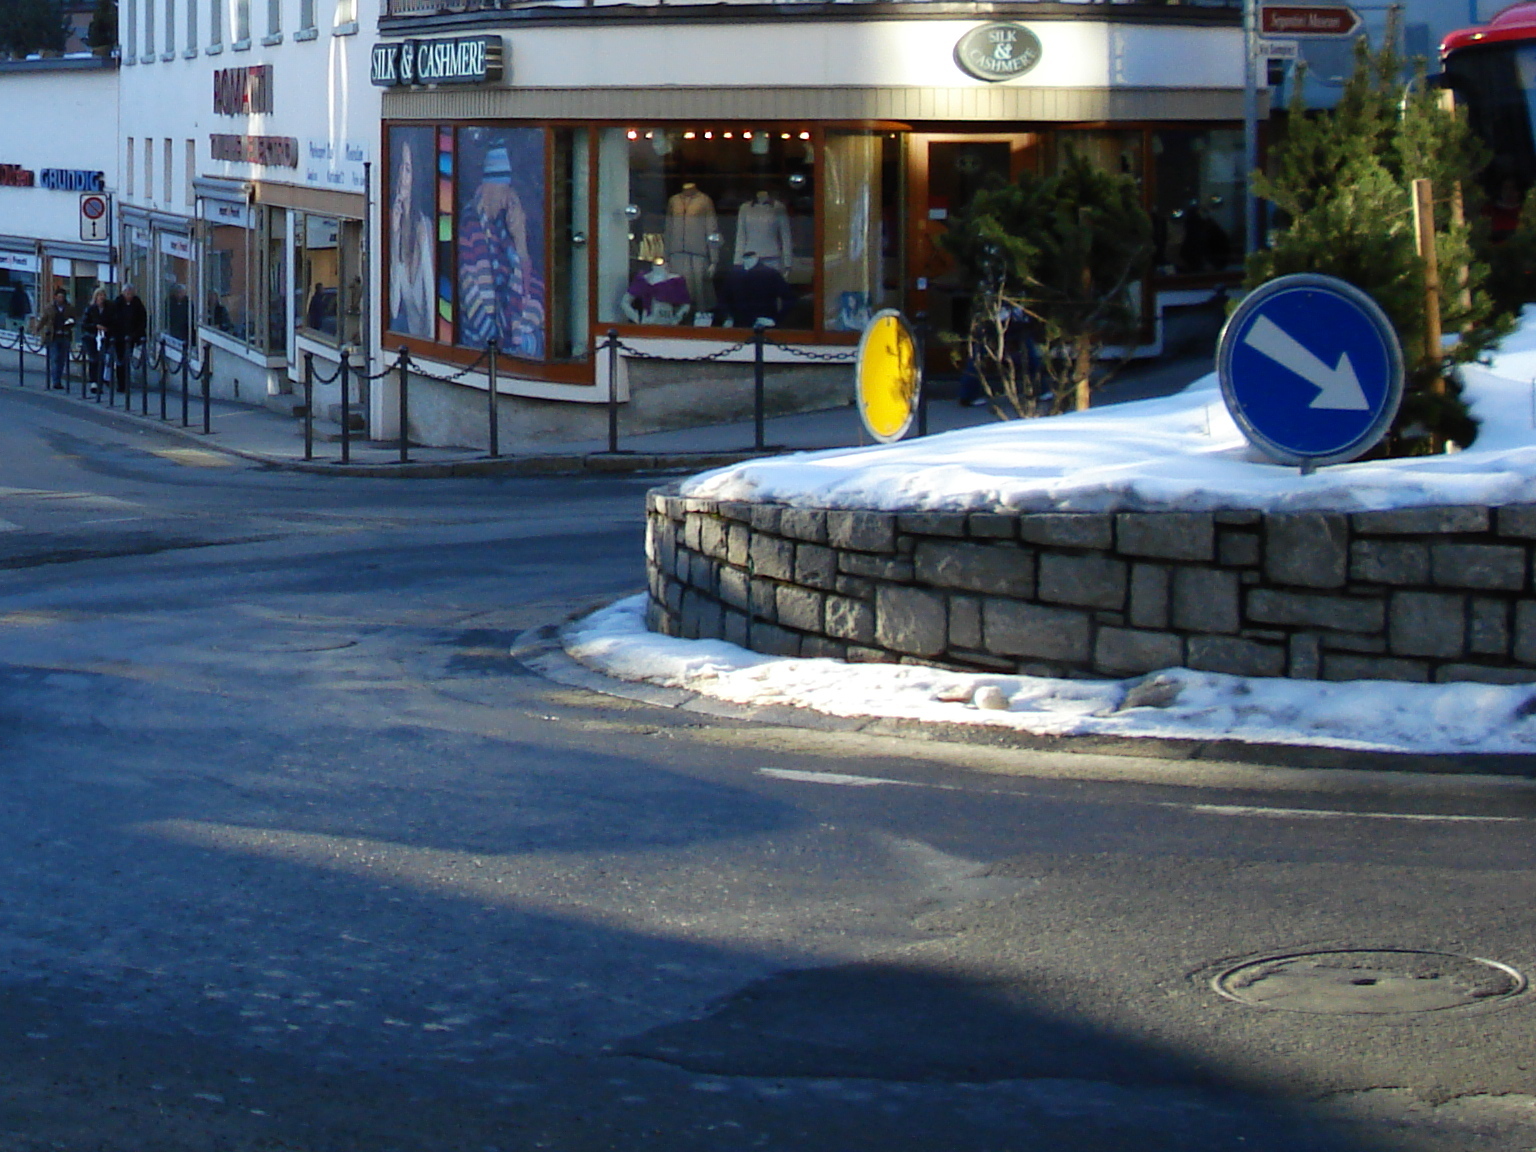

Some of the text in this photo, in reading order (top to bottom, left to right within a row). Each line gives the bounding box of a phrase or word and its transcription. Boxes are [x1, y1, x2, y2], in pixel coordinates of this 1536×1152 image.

[989, 30, 1017, 42] SILK
[372, 41, 486, 80] SILK & CASHMERE
[969, 48, 1037, 73] CASHMERE
[994, 43, 1012, 60] &
[40, 168, 103, 192] GRUNDIG
